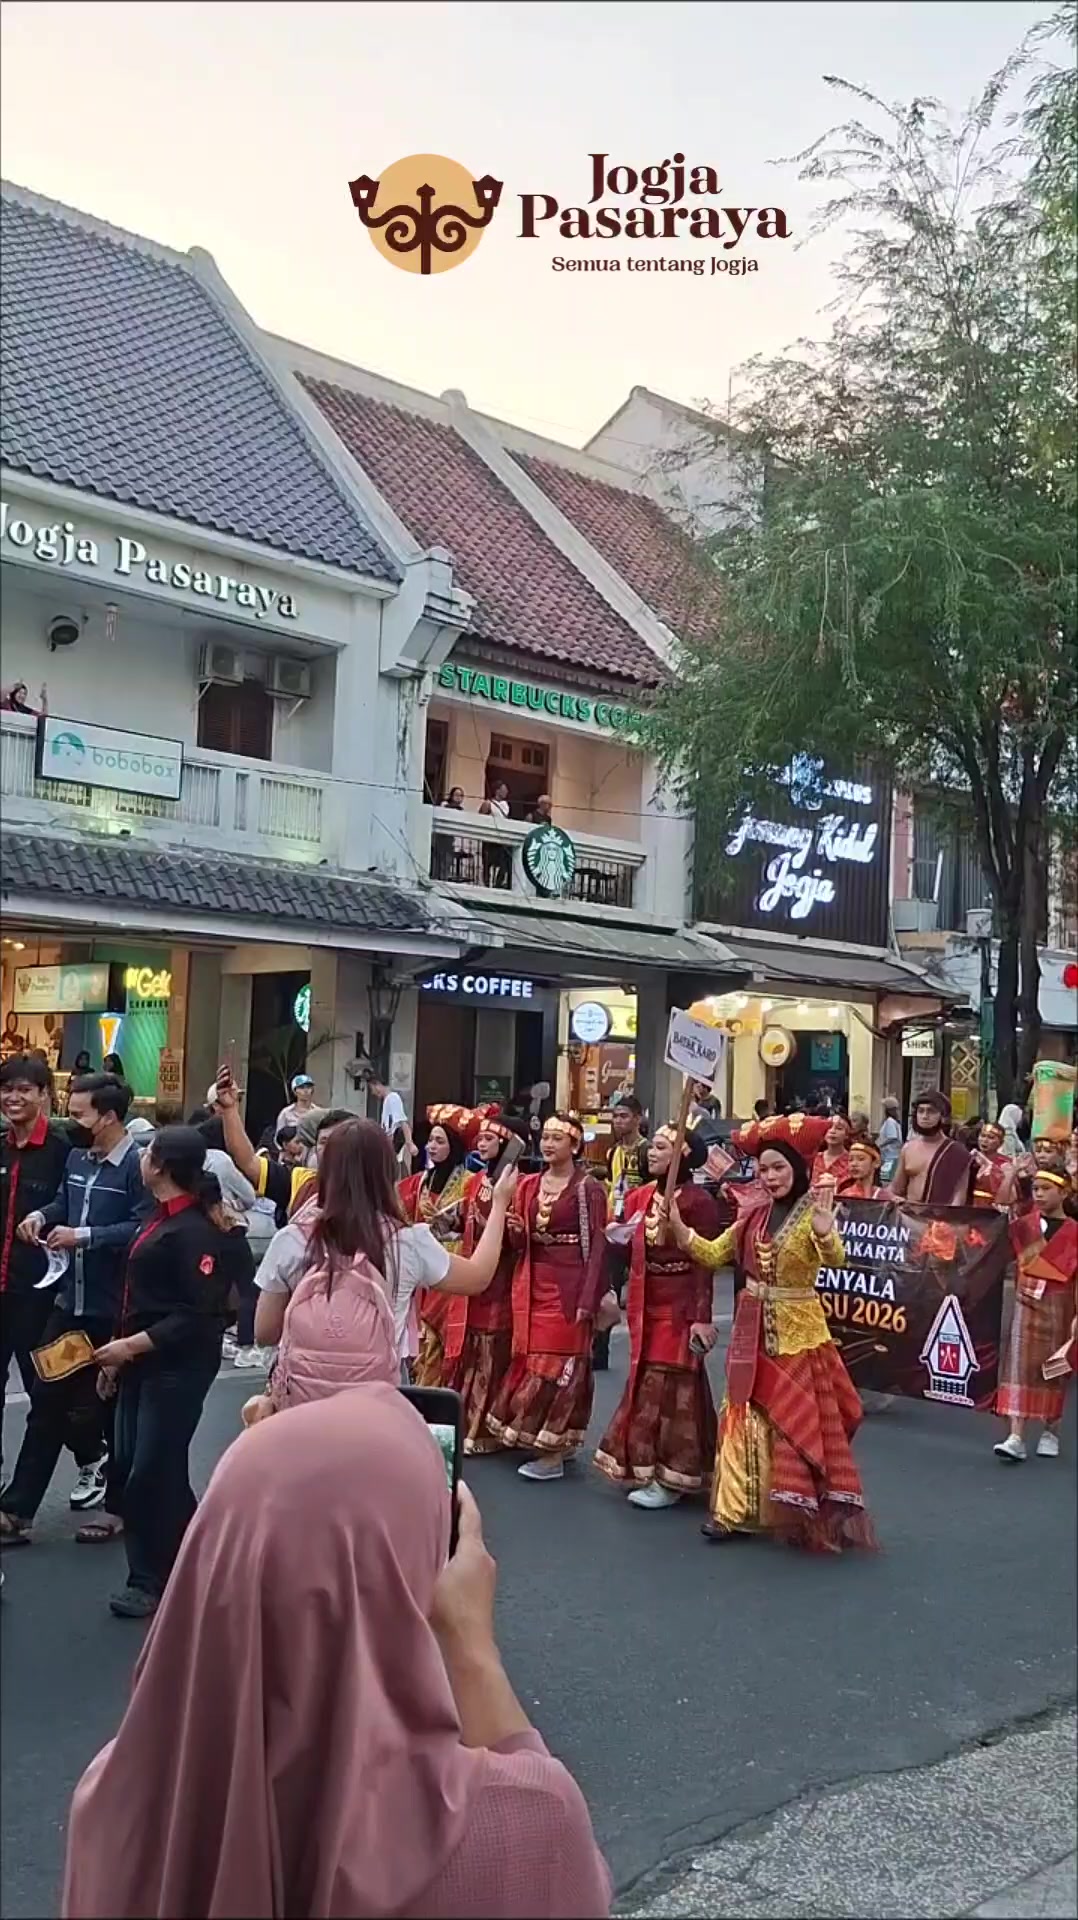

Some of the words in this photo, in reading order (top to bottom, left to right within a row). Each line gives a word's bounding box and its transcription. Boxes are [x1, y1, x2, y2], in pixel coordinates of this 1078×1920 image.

[115, 535, 299, 618] Pasaraya
[438, 662, 593, 724] STARBUCKS
[92, 748, 175, 779] bobobox
[758, 852, 836, 918] Jogja
[462, 975, 533, 998] COFFEE
[841, 1240, 905, 1263] AKARTA
[814, 1266, 896, 1301] ENYALA
[817, 1292, 849, 1320] SU
[851, 1296, 908, 1333] 2026
